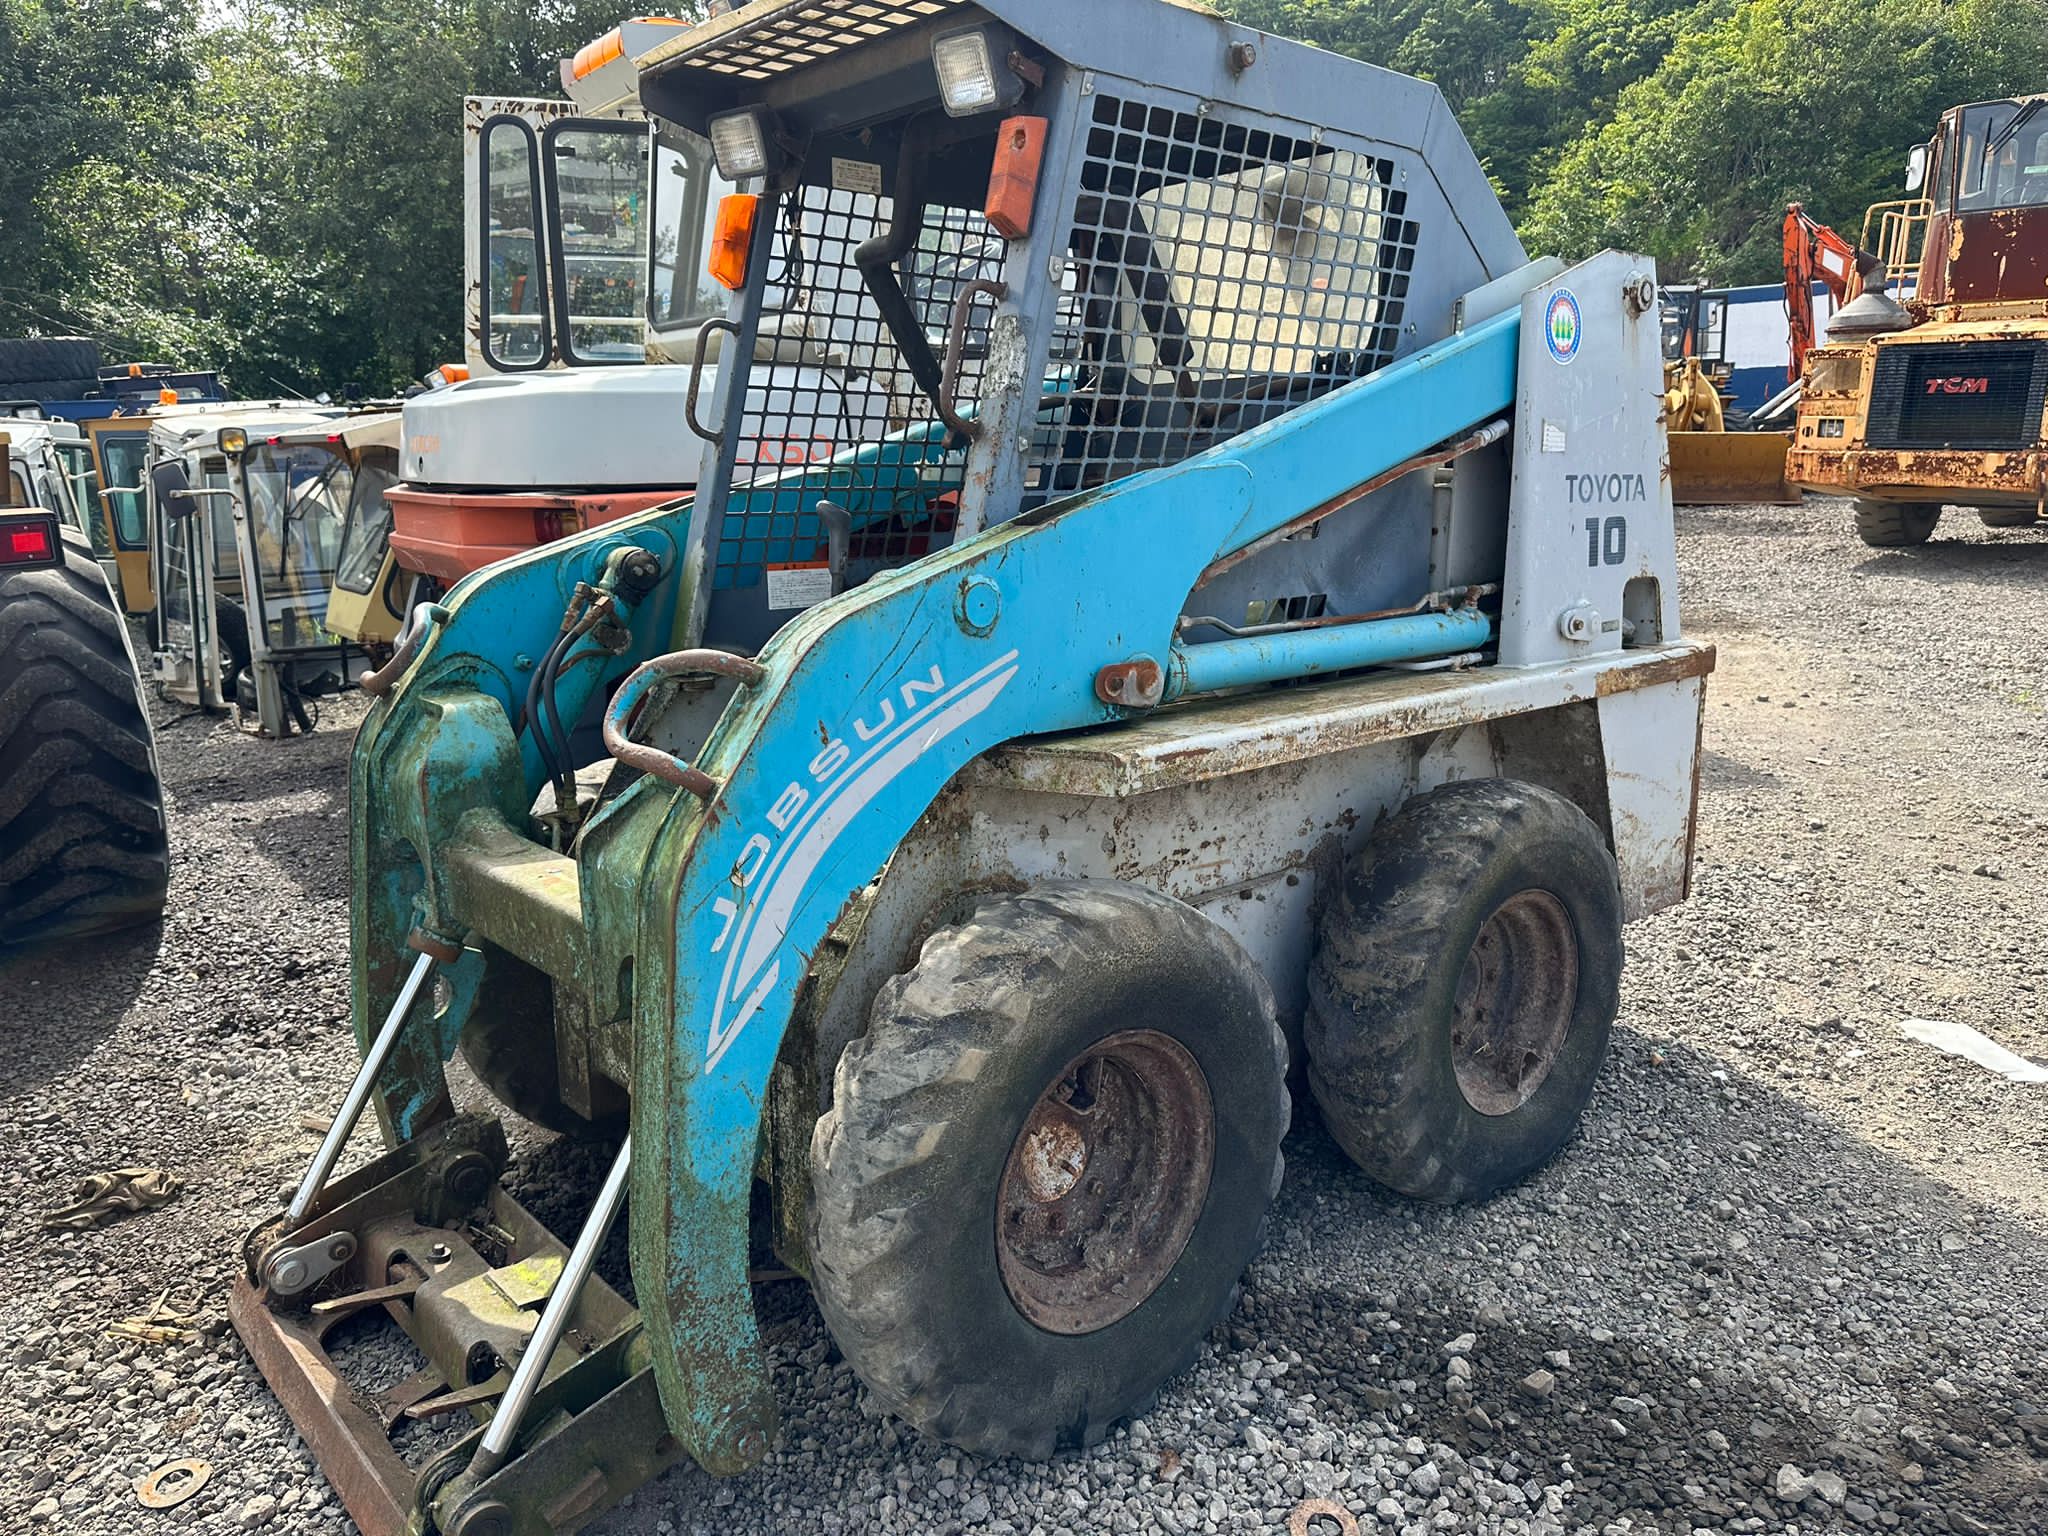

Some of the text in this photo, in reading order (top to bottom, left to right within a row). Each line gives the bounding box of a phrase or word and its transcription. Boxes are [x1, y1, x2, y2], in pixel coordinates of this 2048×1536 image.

[1925, 376, 1989, 394] TCM
[1565, 473, 1646, 503] TOYOTA
[1585, 516, 1626, 567] 10
[710, 663, 945, 952] JOBSUN
